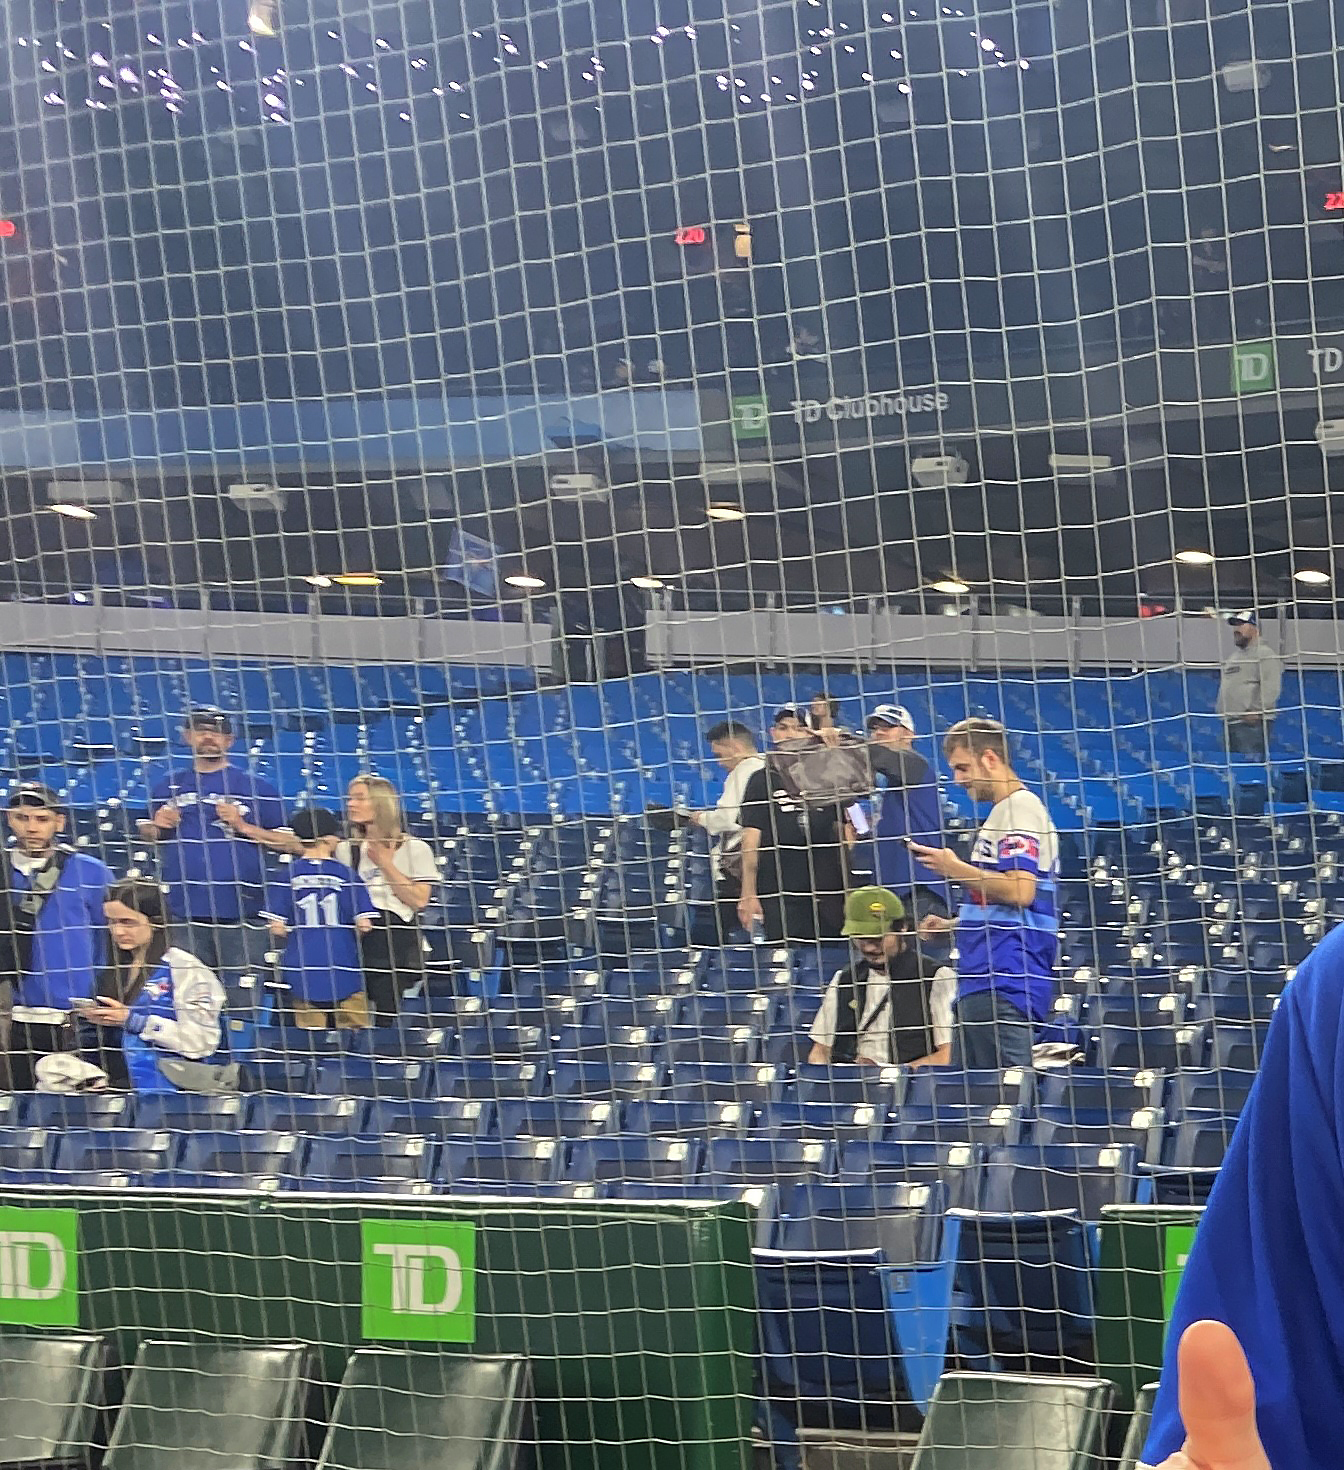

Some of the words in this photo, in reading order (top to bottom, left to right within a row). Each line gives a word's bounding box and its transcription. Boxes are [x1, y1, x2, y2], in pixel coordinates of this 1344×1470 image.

[1307, 348, 1343, 374] TD
[790, 400, 821, 425] TD
[826, 391, 950, 421] Clubhouse
[296, 892, 340, 926] 11
[372, 1243, 463, 1316] TD
